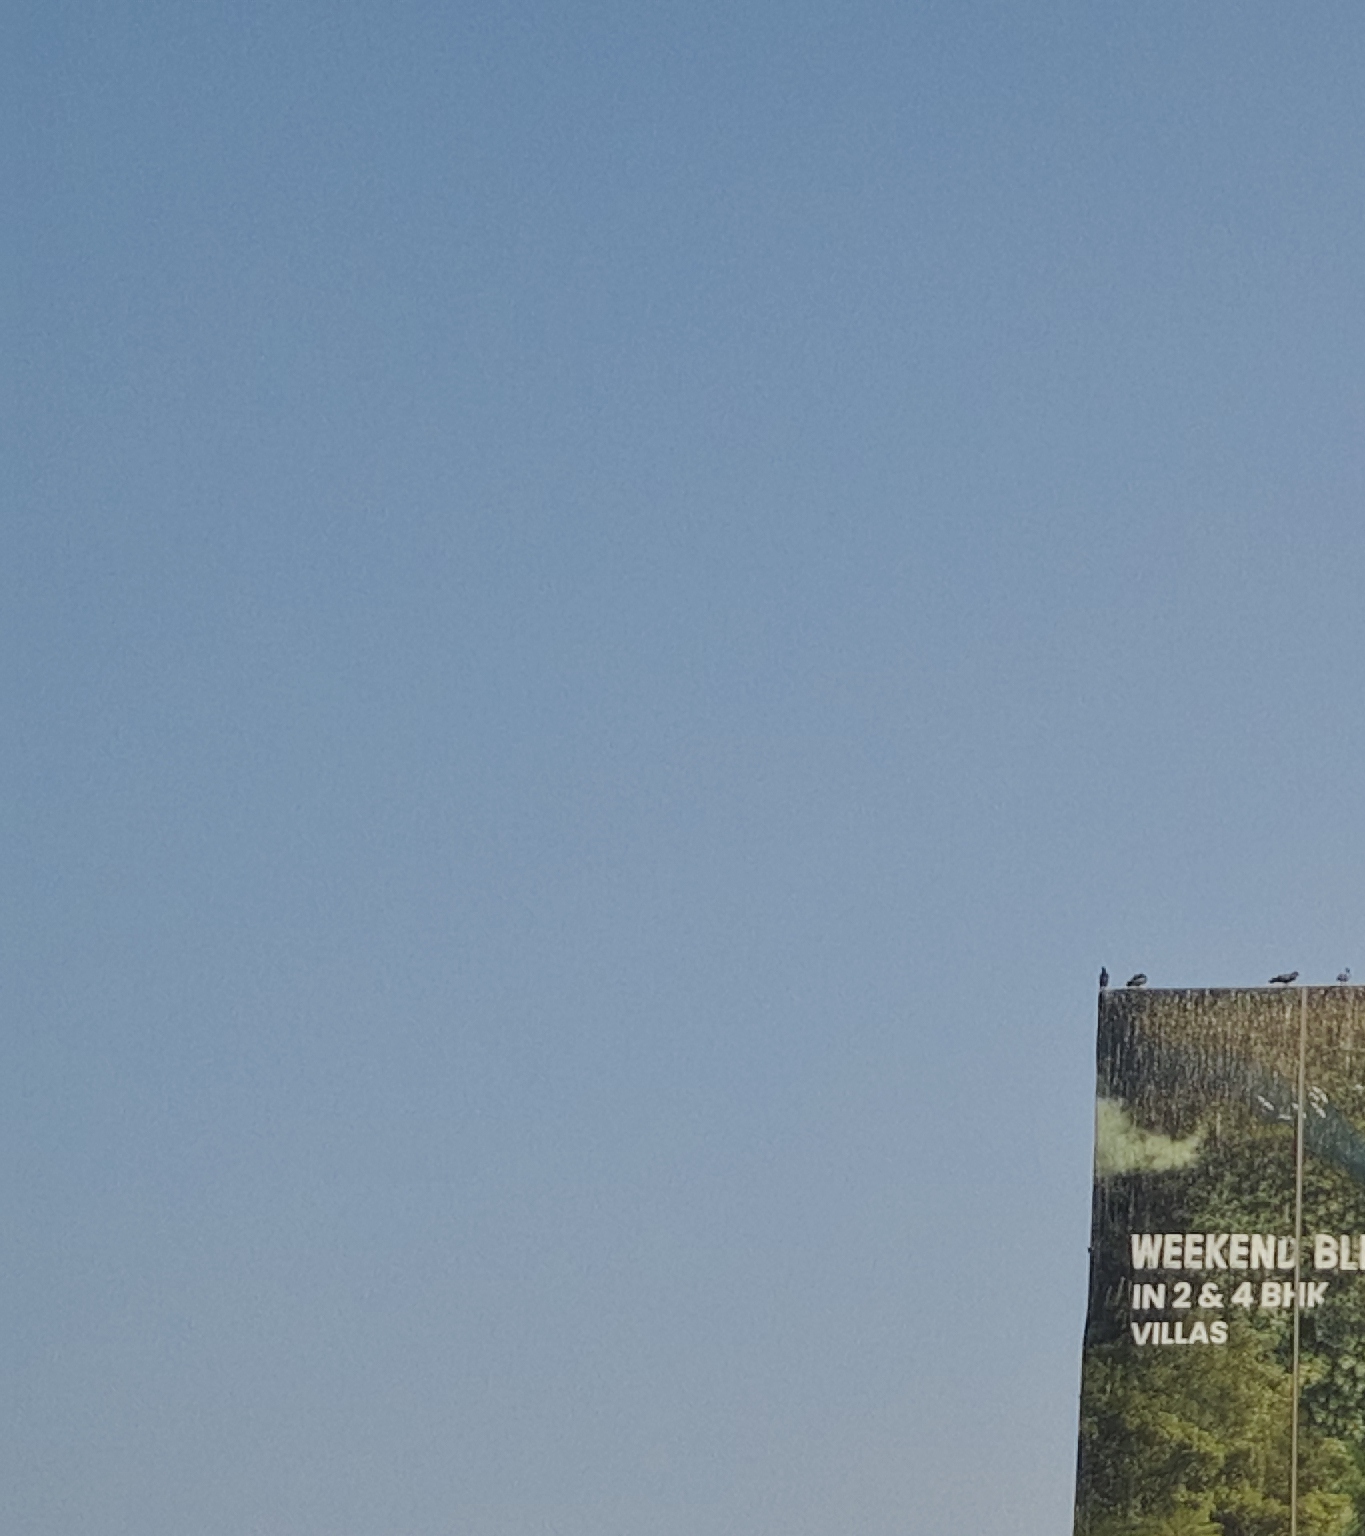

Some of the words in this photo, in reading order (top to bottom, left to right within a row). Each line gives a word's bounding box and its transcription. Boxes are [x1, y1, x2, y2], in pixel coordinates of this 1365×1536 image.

[1131, 1233, 1296, 1271] WEEKEND
[1132, 1283, 1166, 1310] IN
[1173, 1283, 1193, 1308] 2
[1197, 1283, 1223, 1308] &
[1231, 1282, 1254, 1307] 4
[1261, 1281, 1328, 1308] BHK
[1131, 1320, 1229, 1346] VILLAS
